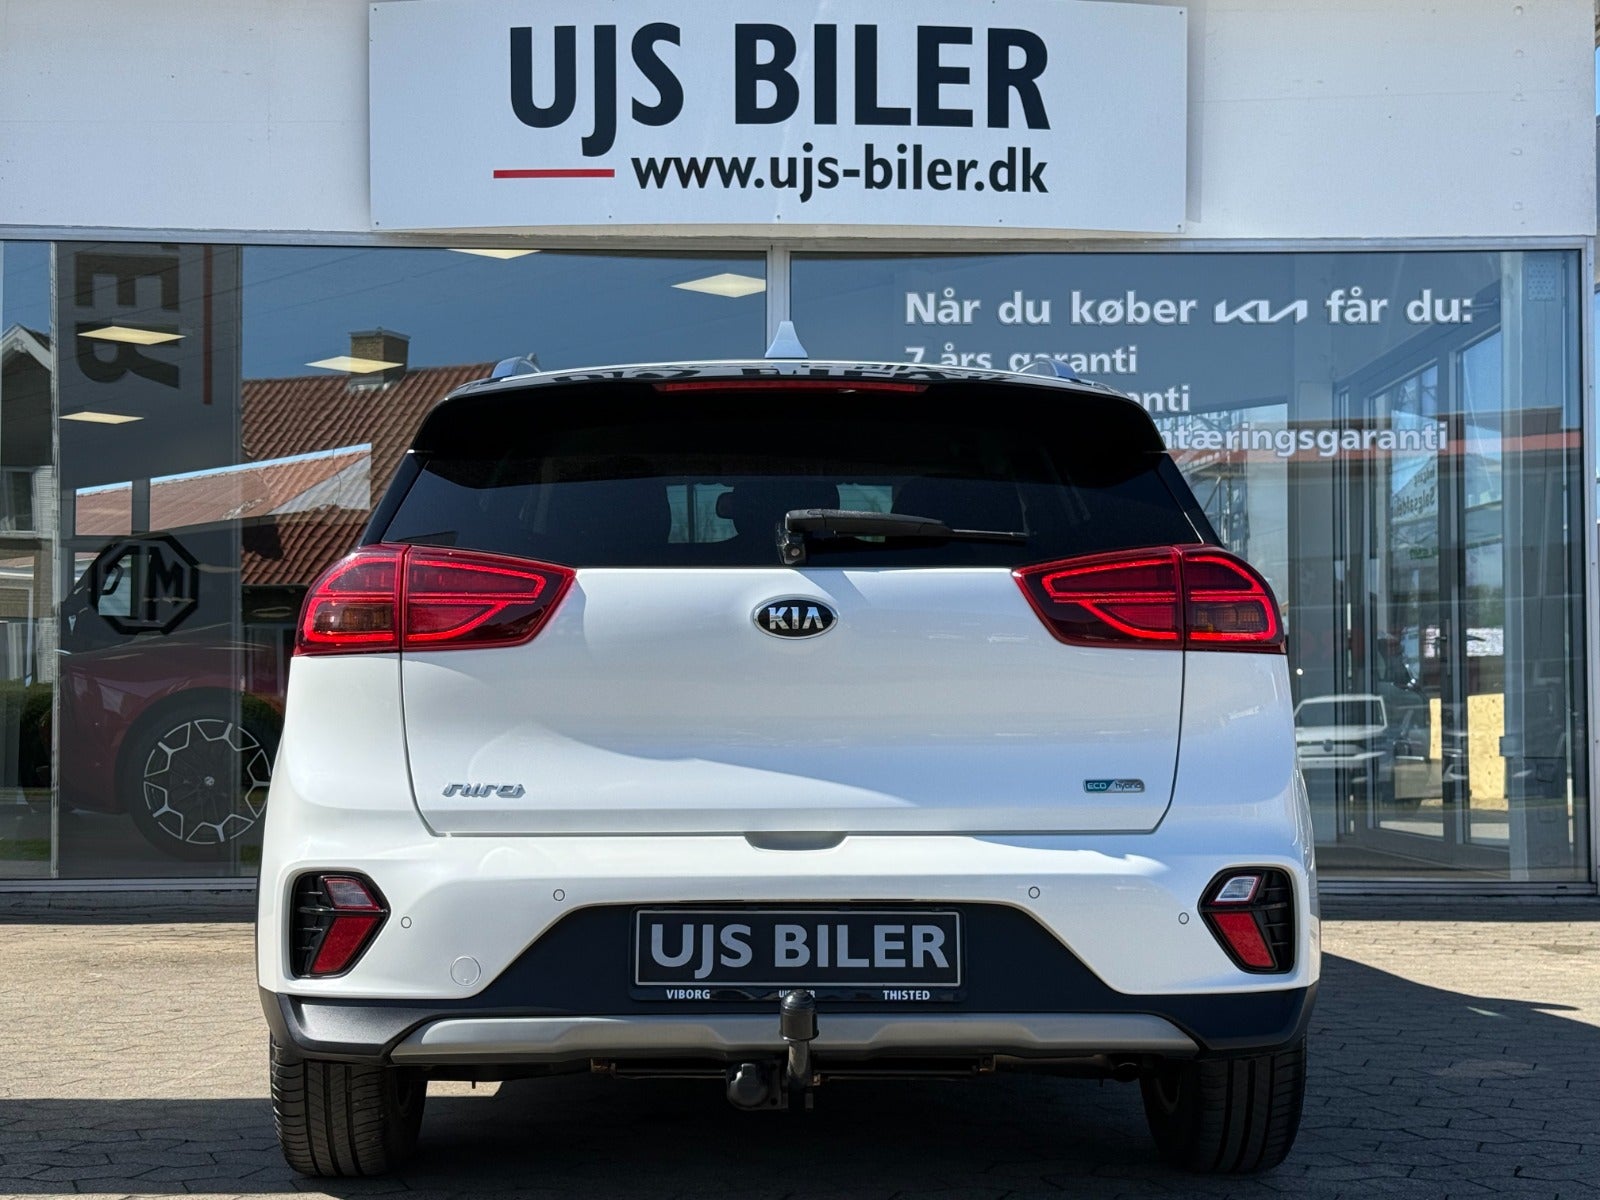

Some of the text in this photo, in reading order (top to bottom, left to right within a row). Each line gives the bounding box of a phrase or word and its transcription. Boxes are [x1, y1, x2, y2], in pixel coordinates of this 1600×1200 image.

[509, 22, 1050, 157] UJS BILER
[631, 143, 1049, 202] www.ujs-biler.dk
[905, 288, 980, 325] Når
[998, 292, 1051, 325] du
[1071, 291, 1197, 325] køber
[1326, 287, 1388, 324] får
[1406, 289, 1474, 324] du:
[905, 346, 924, 363] 7
[941, 343, 991, 369] års
[768, 606, 824, 630] KIA
[1087, 782, 1107, 790] ECO
[651, 924, 950, 979] UJS BILER
[666, 989, 711, 1000] VIBORG
[883, 990, 930, 1001] THISTED
